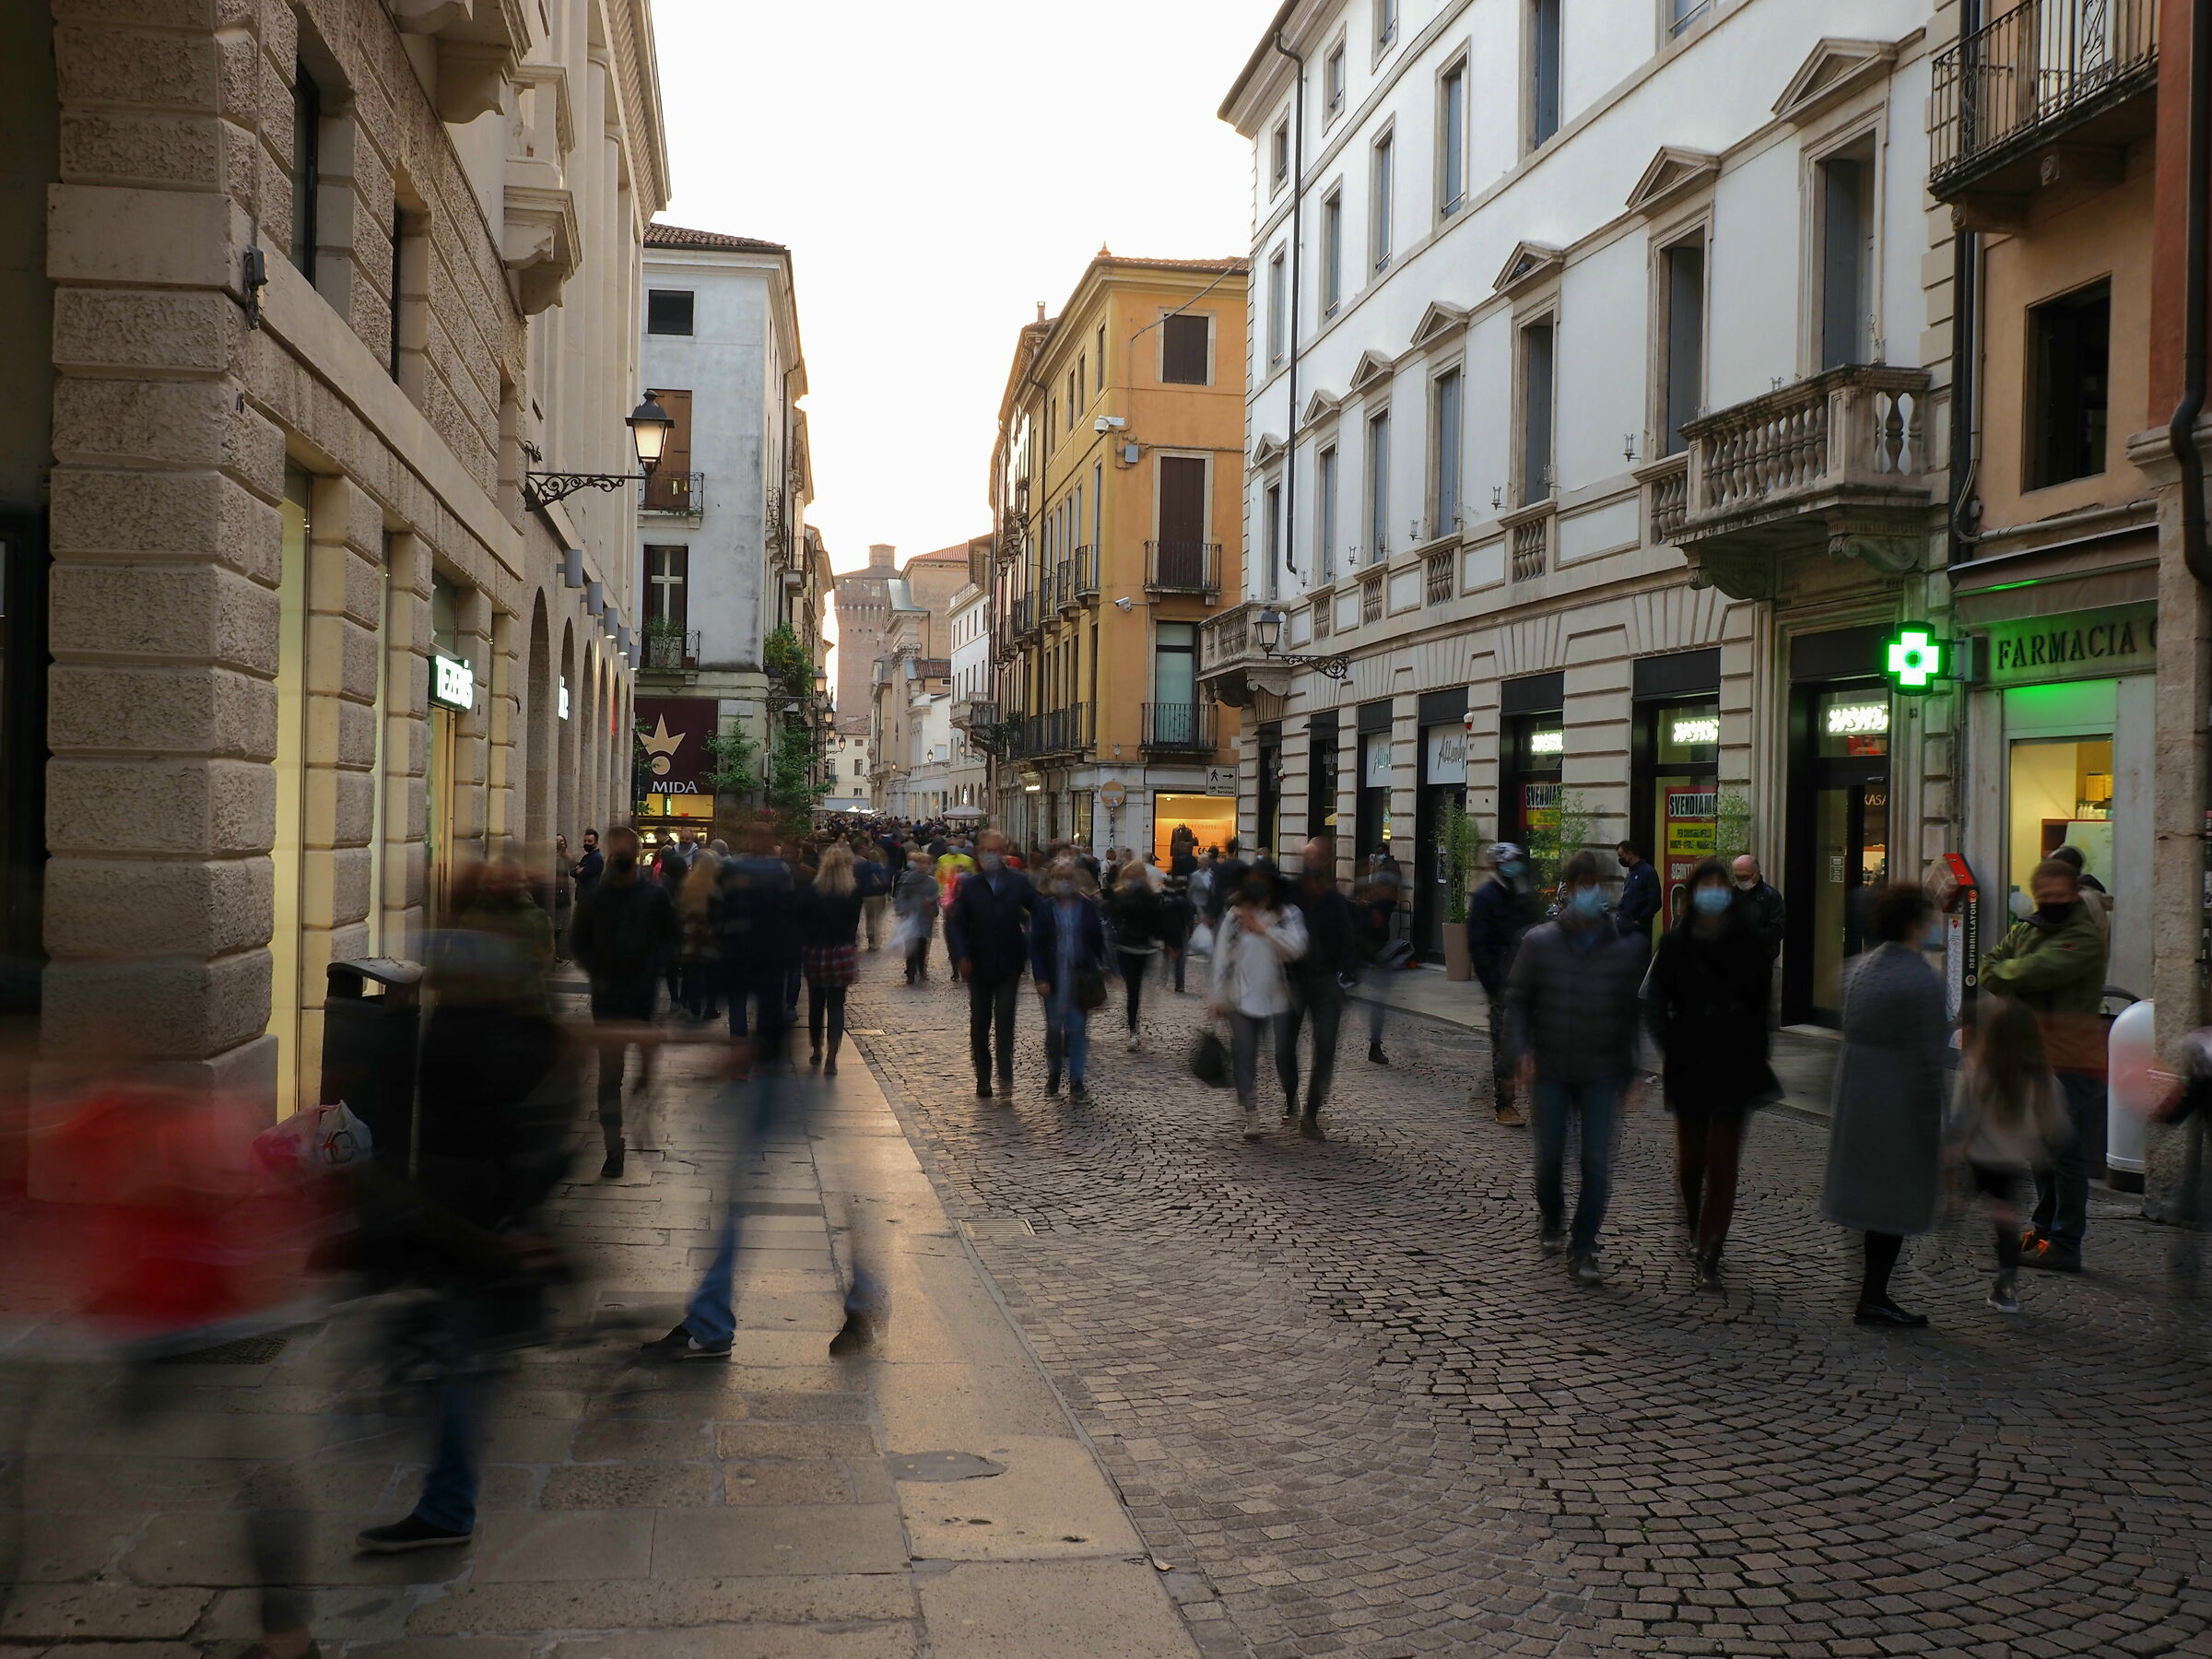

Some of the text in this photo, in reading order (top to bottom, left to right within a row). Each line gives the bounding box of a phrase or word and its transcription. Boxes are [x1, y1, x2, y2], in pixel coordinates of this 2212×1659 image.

[1997, 622, 2137, 670] FARMACIA
[651, 781, 699, 794] MIDA
[1969, 898, 1977, 969] DEFIBRILLATORE
